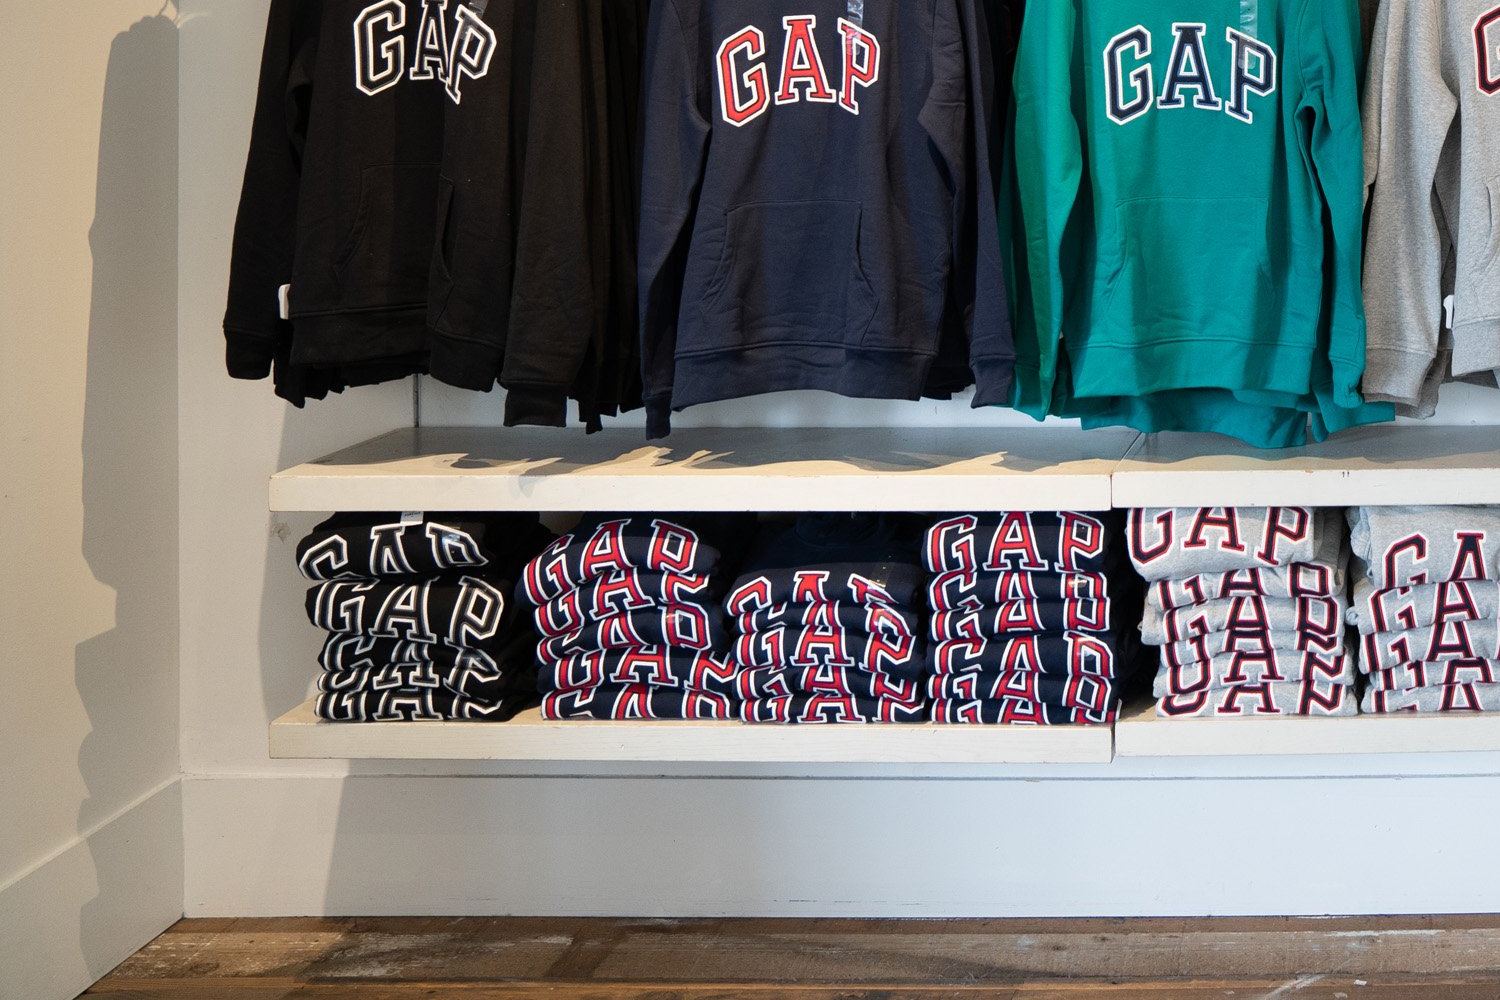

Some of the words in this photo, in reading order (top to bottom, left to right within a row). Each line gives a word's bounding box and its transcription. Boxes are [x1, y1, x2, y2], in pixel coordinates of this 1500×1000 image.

[716, 15, 880, 127] GAP
[1103, 23, 1277, 125] GAP
[928, 511, 1104, 573] GAP
[315, 576, 504, 645] GAP
